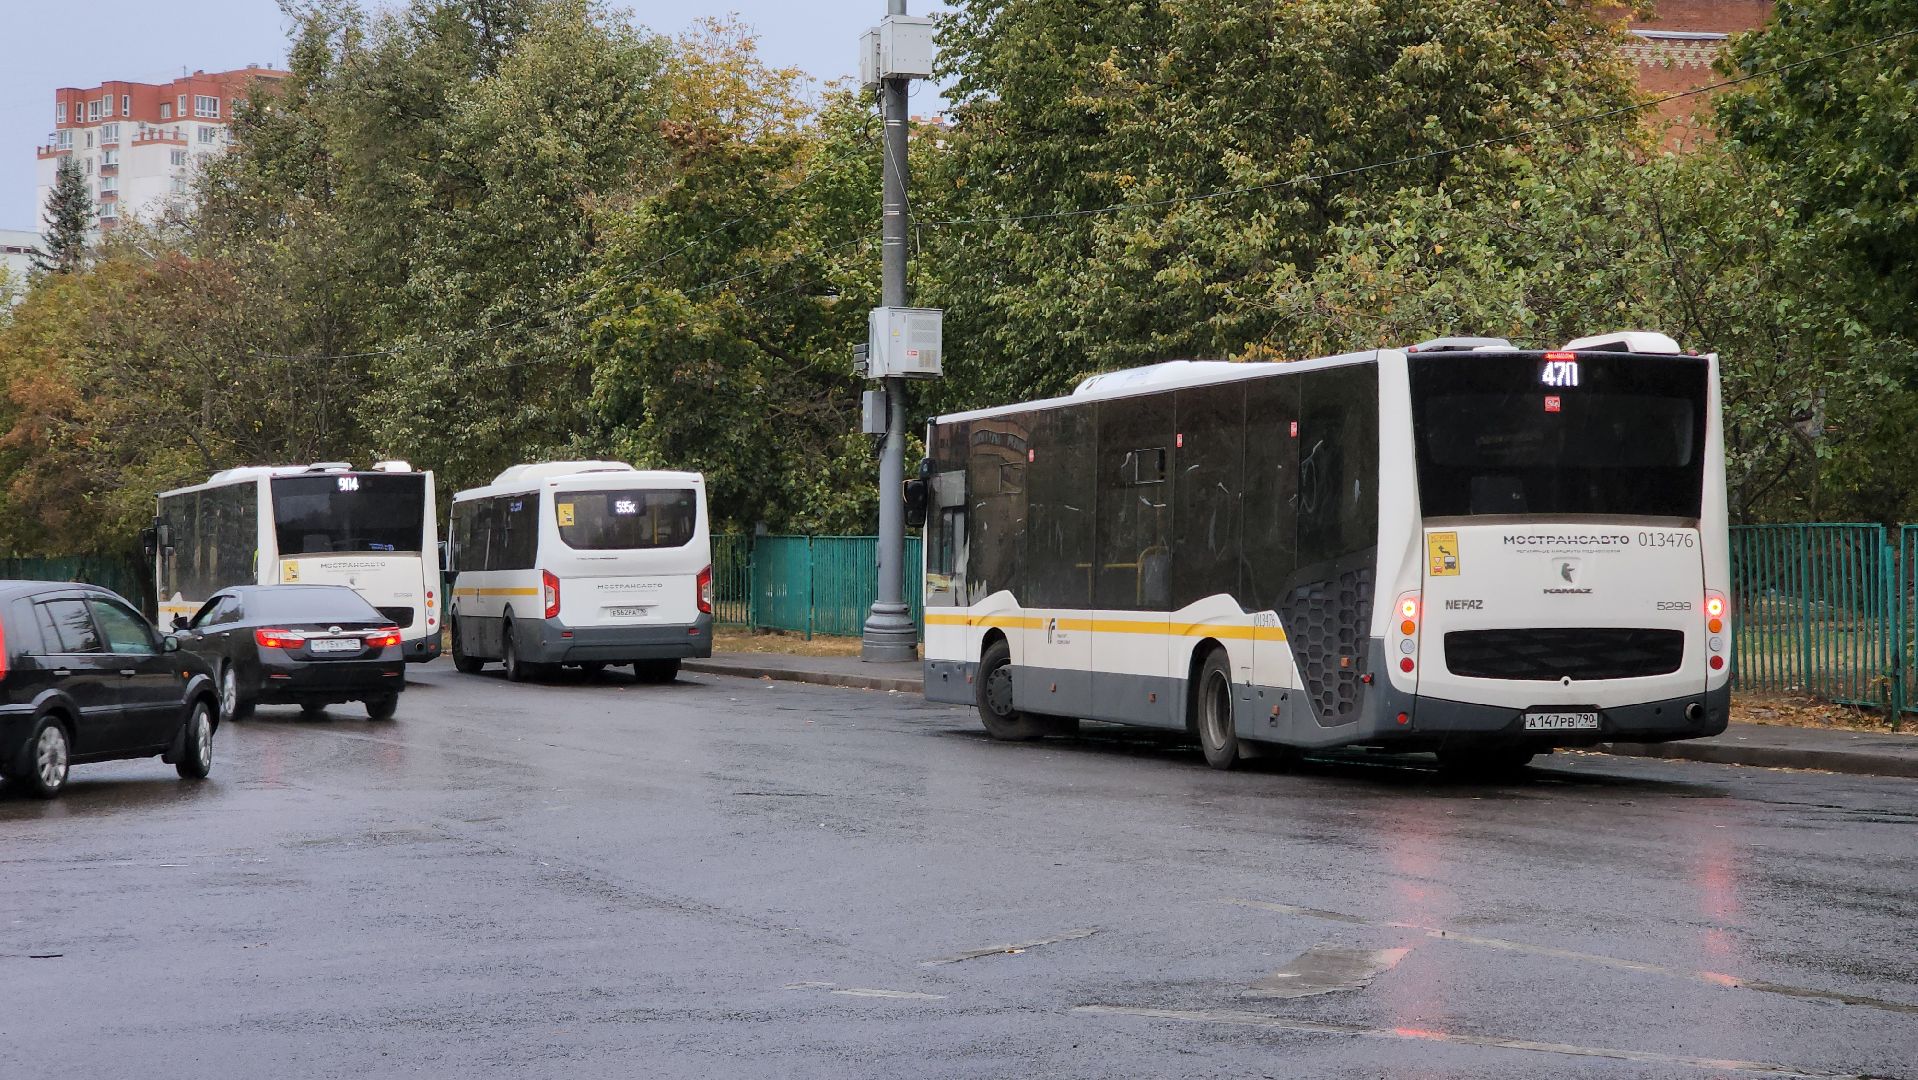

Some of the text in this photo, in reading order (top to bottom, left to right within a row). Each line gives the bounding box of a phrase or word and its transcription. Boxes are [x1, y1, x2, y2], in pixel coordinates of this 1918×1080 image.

[1503, 535, 1630, 545] МОСТРАНСАВТО
[1638, 531, 1694, 548] 013476
[1445, 599, 1484, 610] NEFAZ
[1657, 601, 1692, 611] 5299
